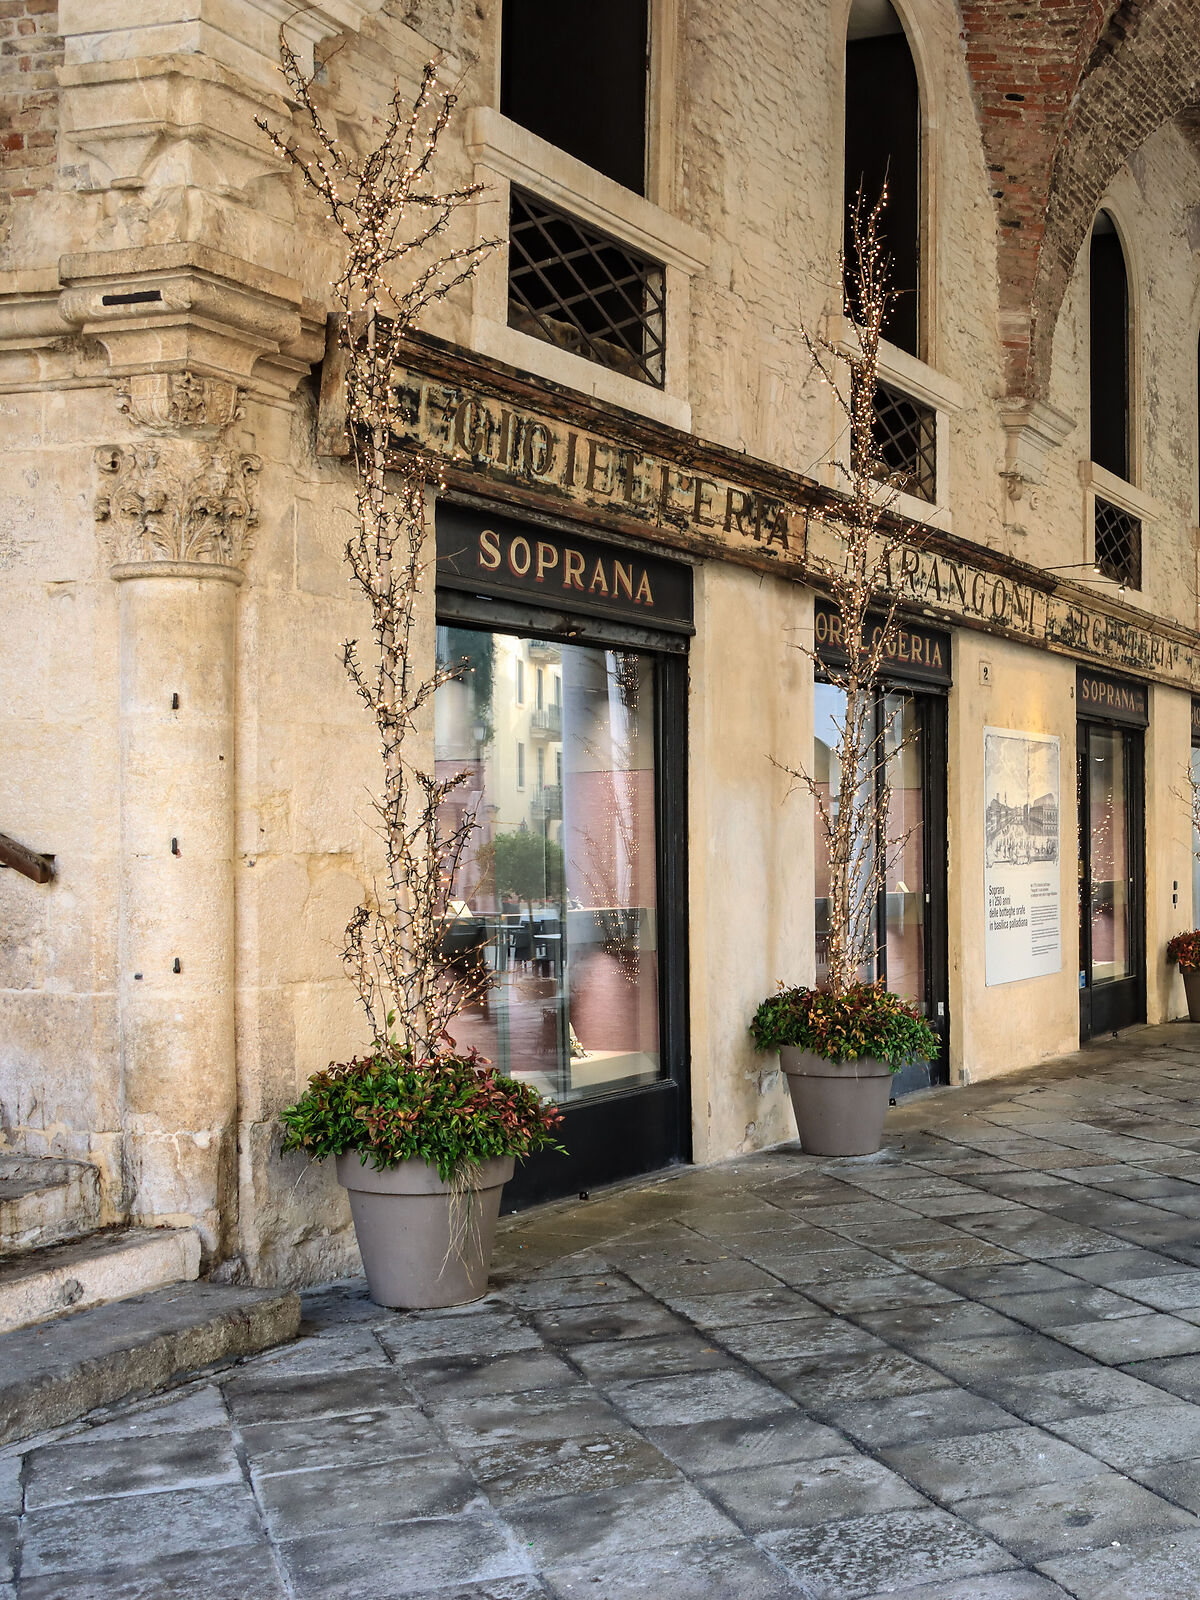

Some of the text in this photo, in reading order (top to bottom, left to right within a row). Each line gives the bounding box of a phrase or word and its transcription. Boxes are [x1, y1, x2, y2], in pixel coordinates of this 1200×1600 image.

[477, 528, 654, 606] SOPRANA
[815, 611, 943, 668] ORLOGERIA
[983, 666, 989, 680] 2
[1069, 686, 1075, 699] 3
[1082, 678, 1136, 712] SOPRANA
[989, 885, 1005, 896] Soprana
[989, 907, 999, 918] delle
[999, 906, 1016, 919] botteghe
[994, 919, 1009, 931] basilica
